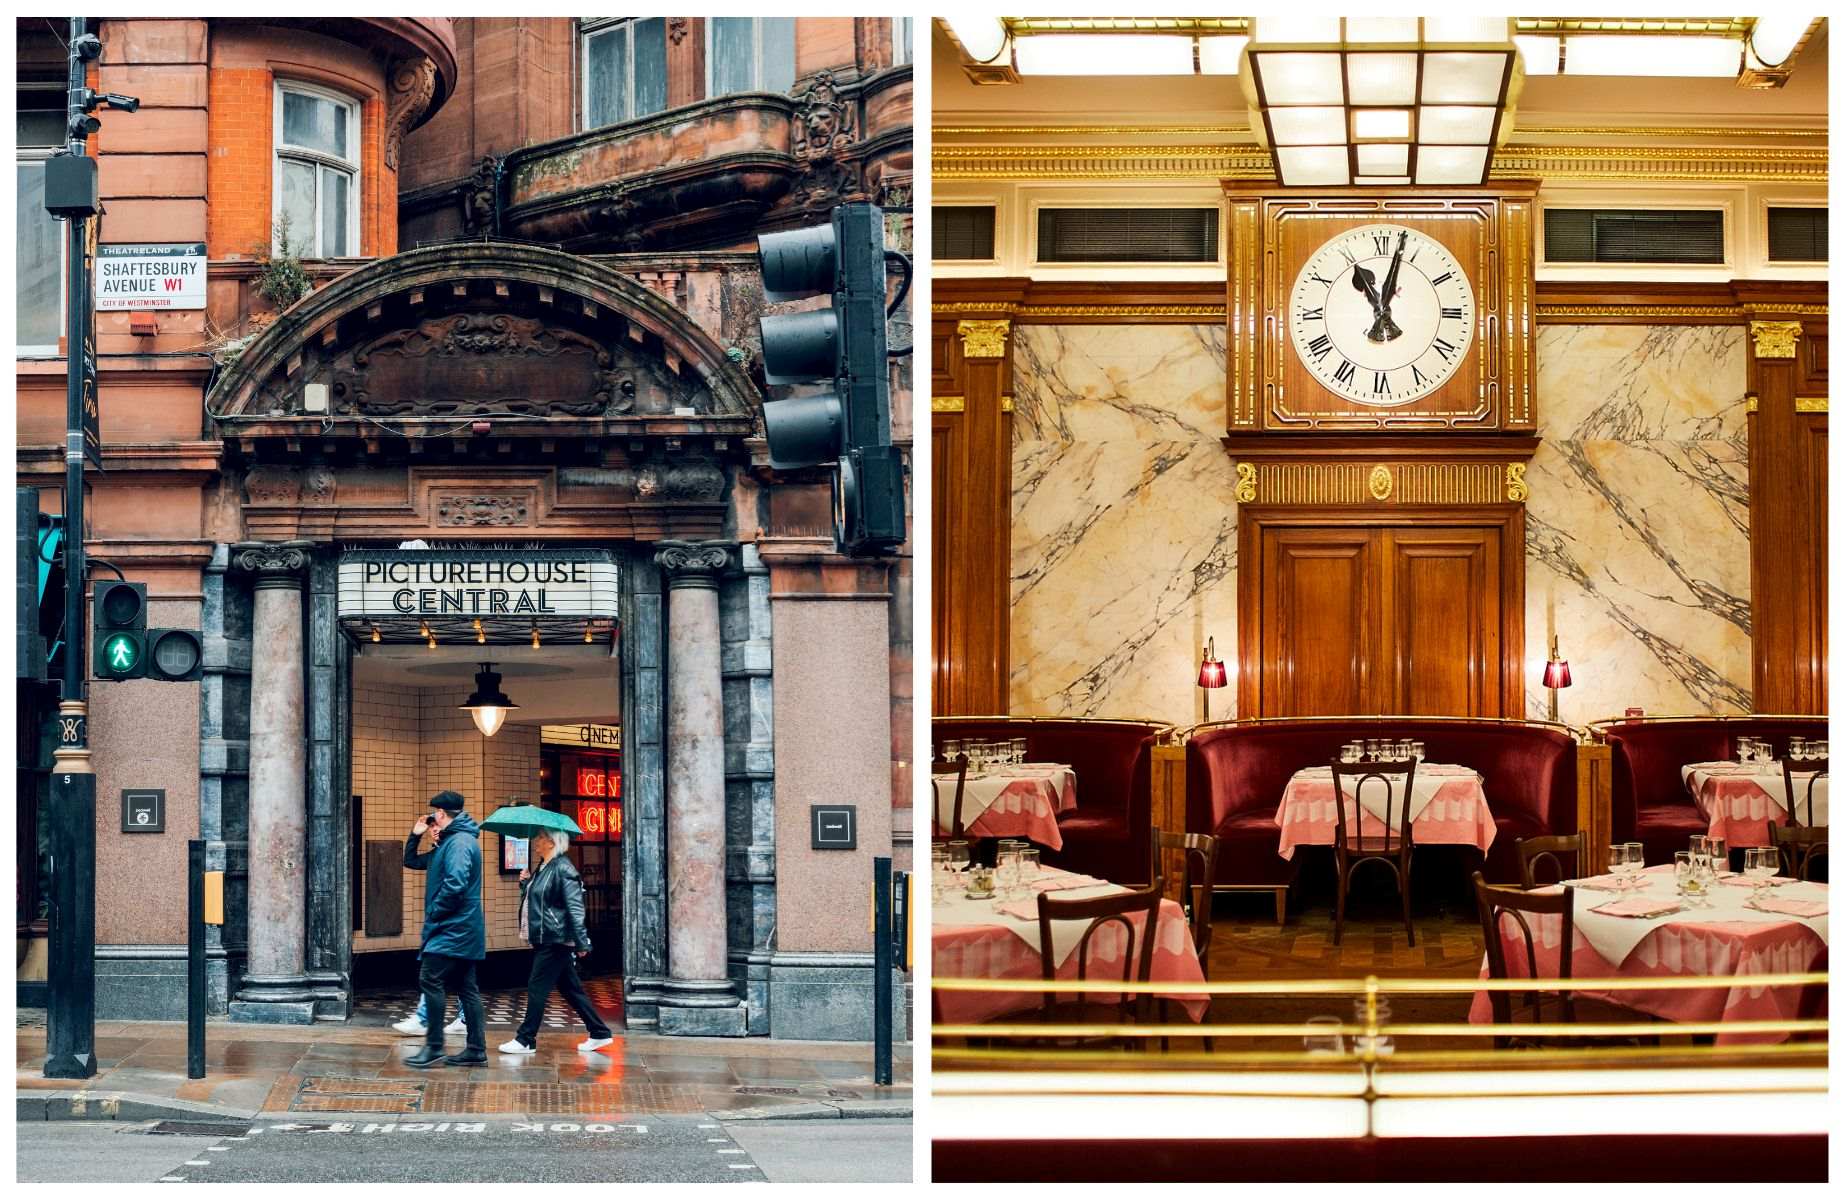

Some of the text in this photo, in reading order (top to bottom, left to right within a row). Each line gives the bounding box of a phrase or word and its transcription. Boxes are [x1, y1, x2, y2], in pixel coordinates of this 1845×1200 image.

[103, 247, 171, 255] THEATRELAND
[1373, 236, 1389, 256] XII
[103, 262, 198, 276] SHAFTESBURY
[103, 278, 182, 292] AVENUE W1
[366, 561, 587, 584] PICTUREHOUSE
[392, 588, 556, 614] CENTRAL
[580, 726, 619, 744] CNEM
[64, 775, 71, 784] 5
[511, 1122, 648, 1134] LOOK
